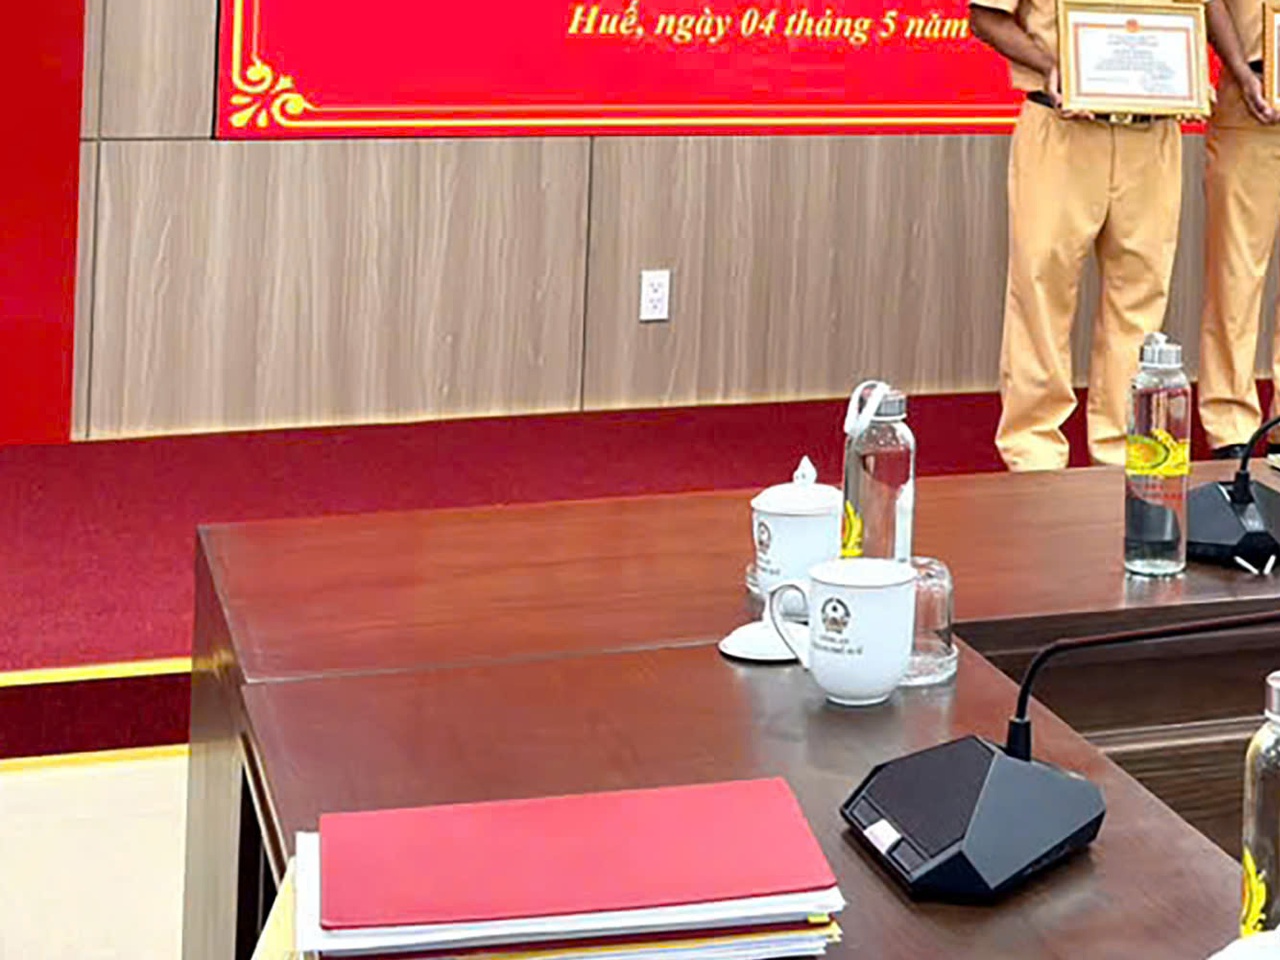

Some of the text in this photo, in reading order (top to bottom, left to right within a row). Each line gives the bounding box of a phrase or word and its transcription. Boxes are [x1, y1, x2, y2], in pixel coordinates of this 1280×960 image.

[654, 8, 732, 44] ngày
[740, 7, 777, 38] 04
[783, 8, 873, 45] tháng
[879, 10, 899, 39] 5
[904, 12, 969, 39] năm
